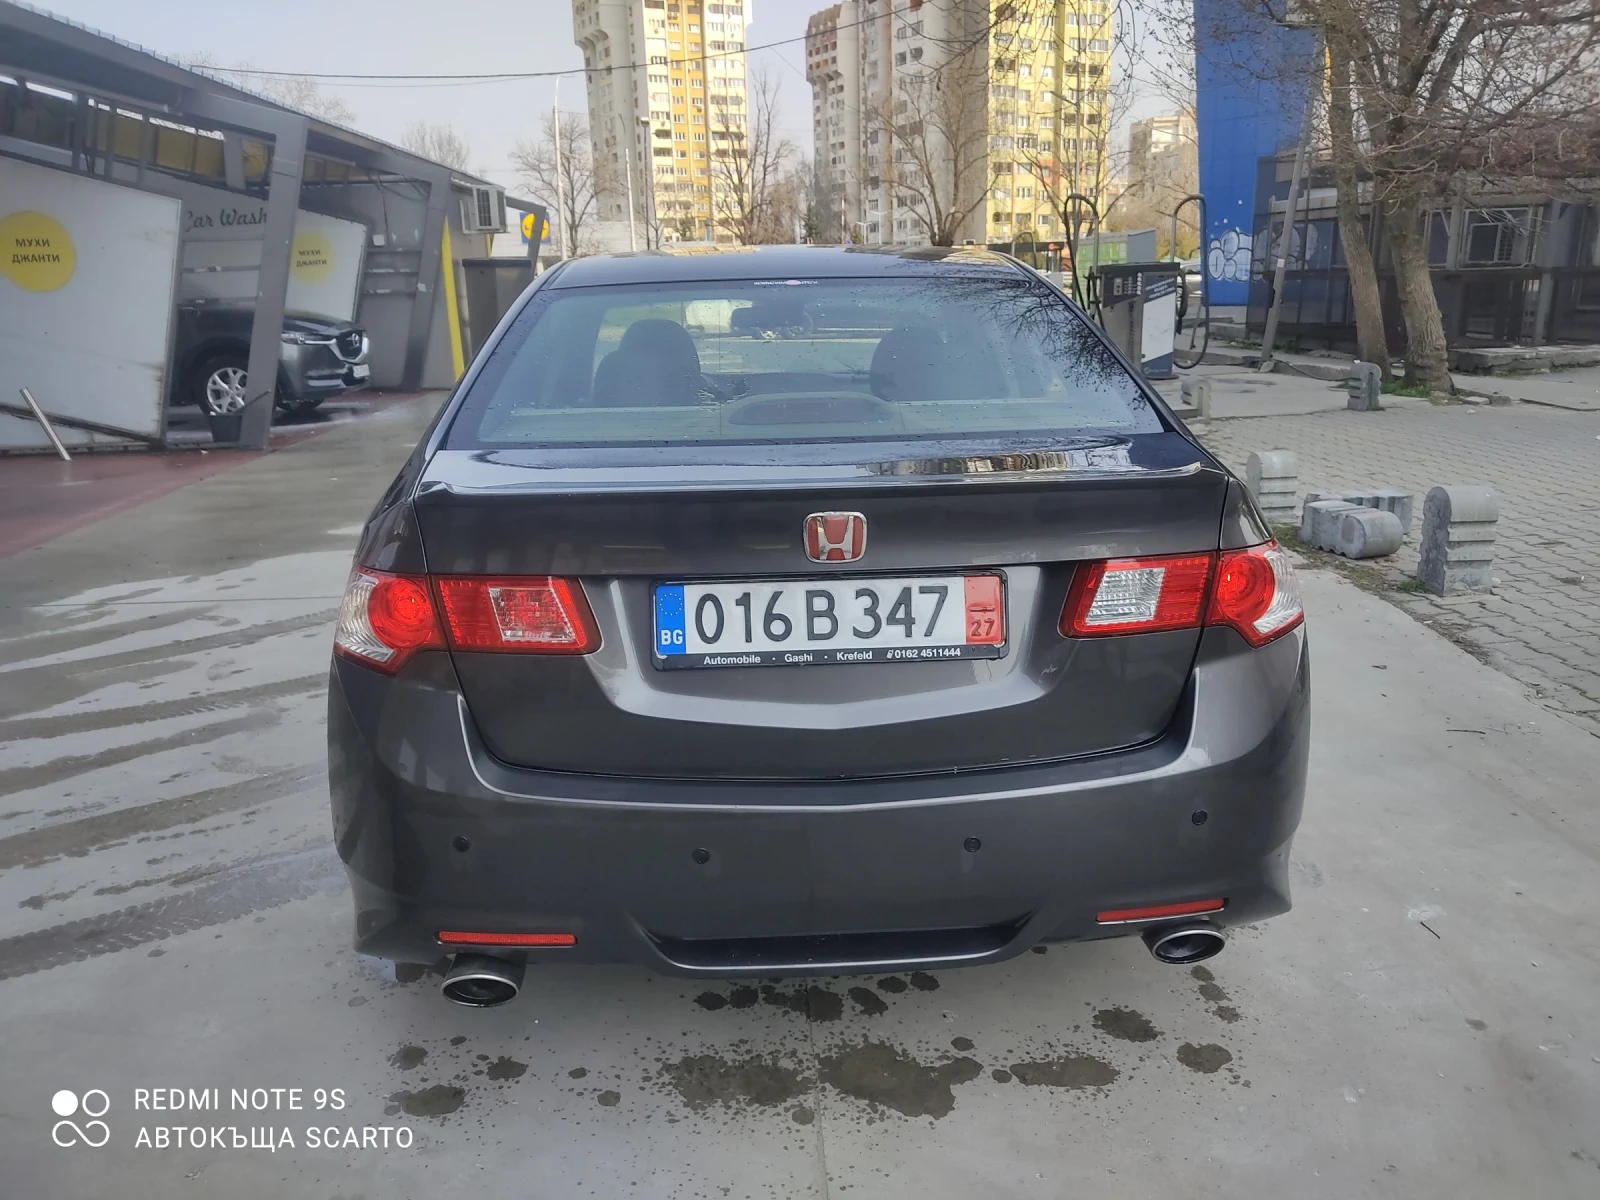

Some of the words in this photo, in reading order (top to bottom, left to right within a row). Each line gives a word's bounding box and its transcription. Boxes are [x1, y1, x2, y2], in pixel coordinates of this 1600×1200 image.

[220, 207, 267, 226] Wash
[15, 238, 50, 248] МУХИ
[12, 253, 60, 264] ДЖАНТИ
[971, 618, 995, 637] 27
[661, 629, 683, 645] BG
[703, 655, 761, 665] Automobile
[784, 652, 813, 663] Gashi
[836, 650, 873, 660] Krefeld
[894, 649, 918, 659] 0162
[920, 647, 961, 658] 4511444
